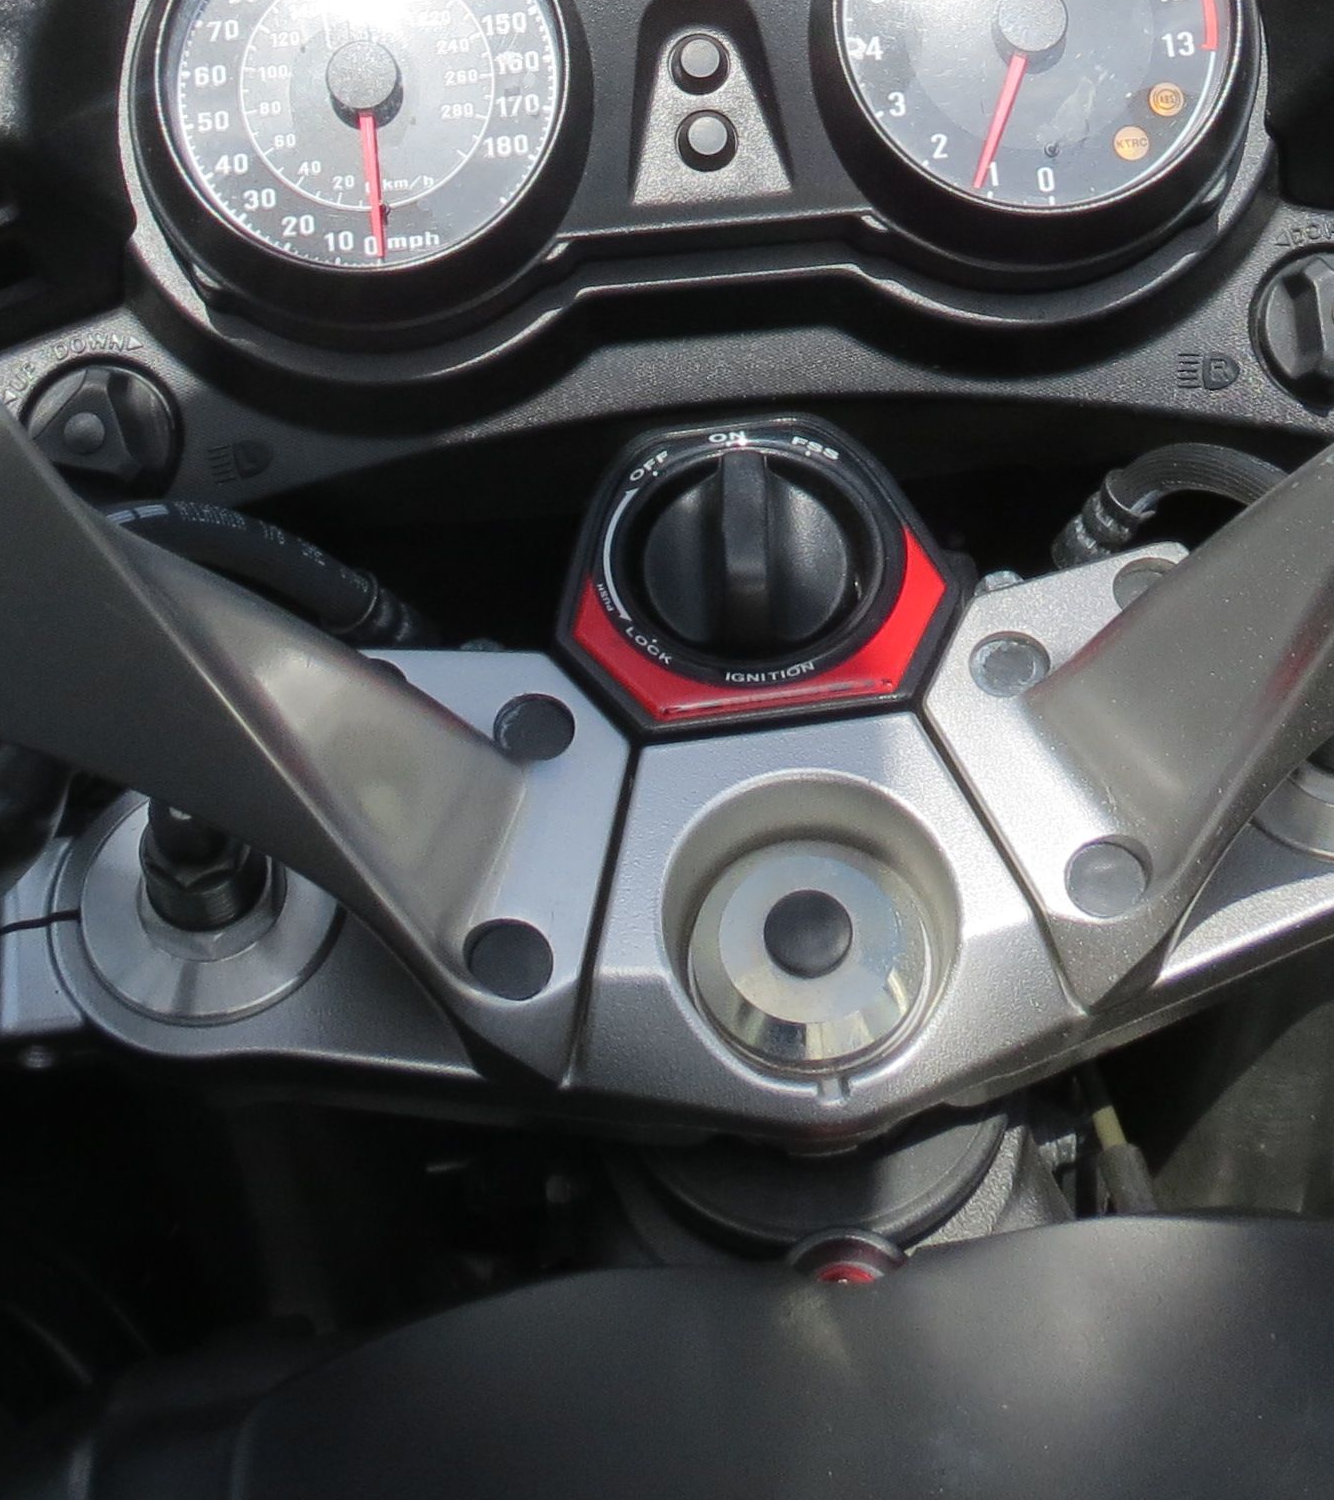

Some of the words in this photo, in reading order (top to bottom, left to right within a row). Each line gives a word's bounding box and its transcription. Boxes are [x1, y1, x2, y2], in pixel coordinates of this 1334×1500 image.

[207, 18, 240, 42] 70
[481, 11, 528, 37] 150
[269, 30, 302, 48] 120
[436, 37, 470, 56] 240
[863, 37, 884, 61] 4
[1160, 31, 1196, 57] 13
[257, 64, 289, 80] 100
[495, 50, 542, 76] 160
[194, 65, 227, 87] 60
[444, 69, 479, 86] 260
[258, 100, 282, 117] 80
[440, 103, 475, 120] 280
[495, 94, 542, 119] 170
[889, 91, 907, 117] 3
[196, 110, 230, 133] 50
[273, 133, 297, 150] 60
[483, 133, 530, 158] 180
[930, 133, 949, 160] 2
[1116, 137, 1148, 149] KTRC
[214, 153, 249, 176] 40
[298, 160, 323, 176] 40
[987, 162, 999, 187] 1
[332, 174, 356, 190] 20
[382, 173, 435, 191] km/h
[1037, 167, 1056, 192] 0
[242, 187, 277, 211] 30
[281, 214, 316, 237] 20
[323, 230, 355, 253] 10
[363, 235, 379, 257] 0
[386, 229, 441, 254] mph
[53, 332, 126, 362] DOWN
[628, 449, 669, 483] OFF
[708, 430, 746, 445] ON
[790, 435, 840, 462] FSS
[595, 582, 615, 614] PUSH
[624, 626, 674, 665] LOCK
[724, 661, 816, 684] IGNITION
